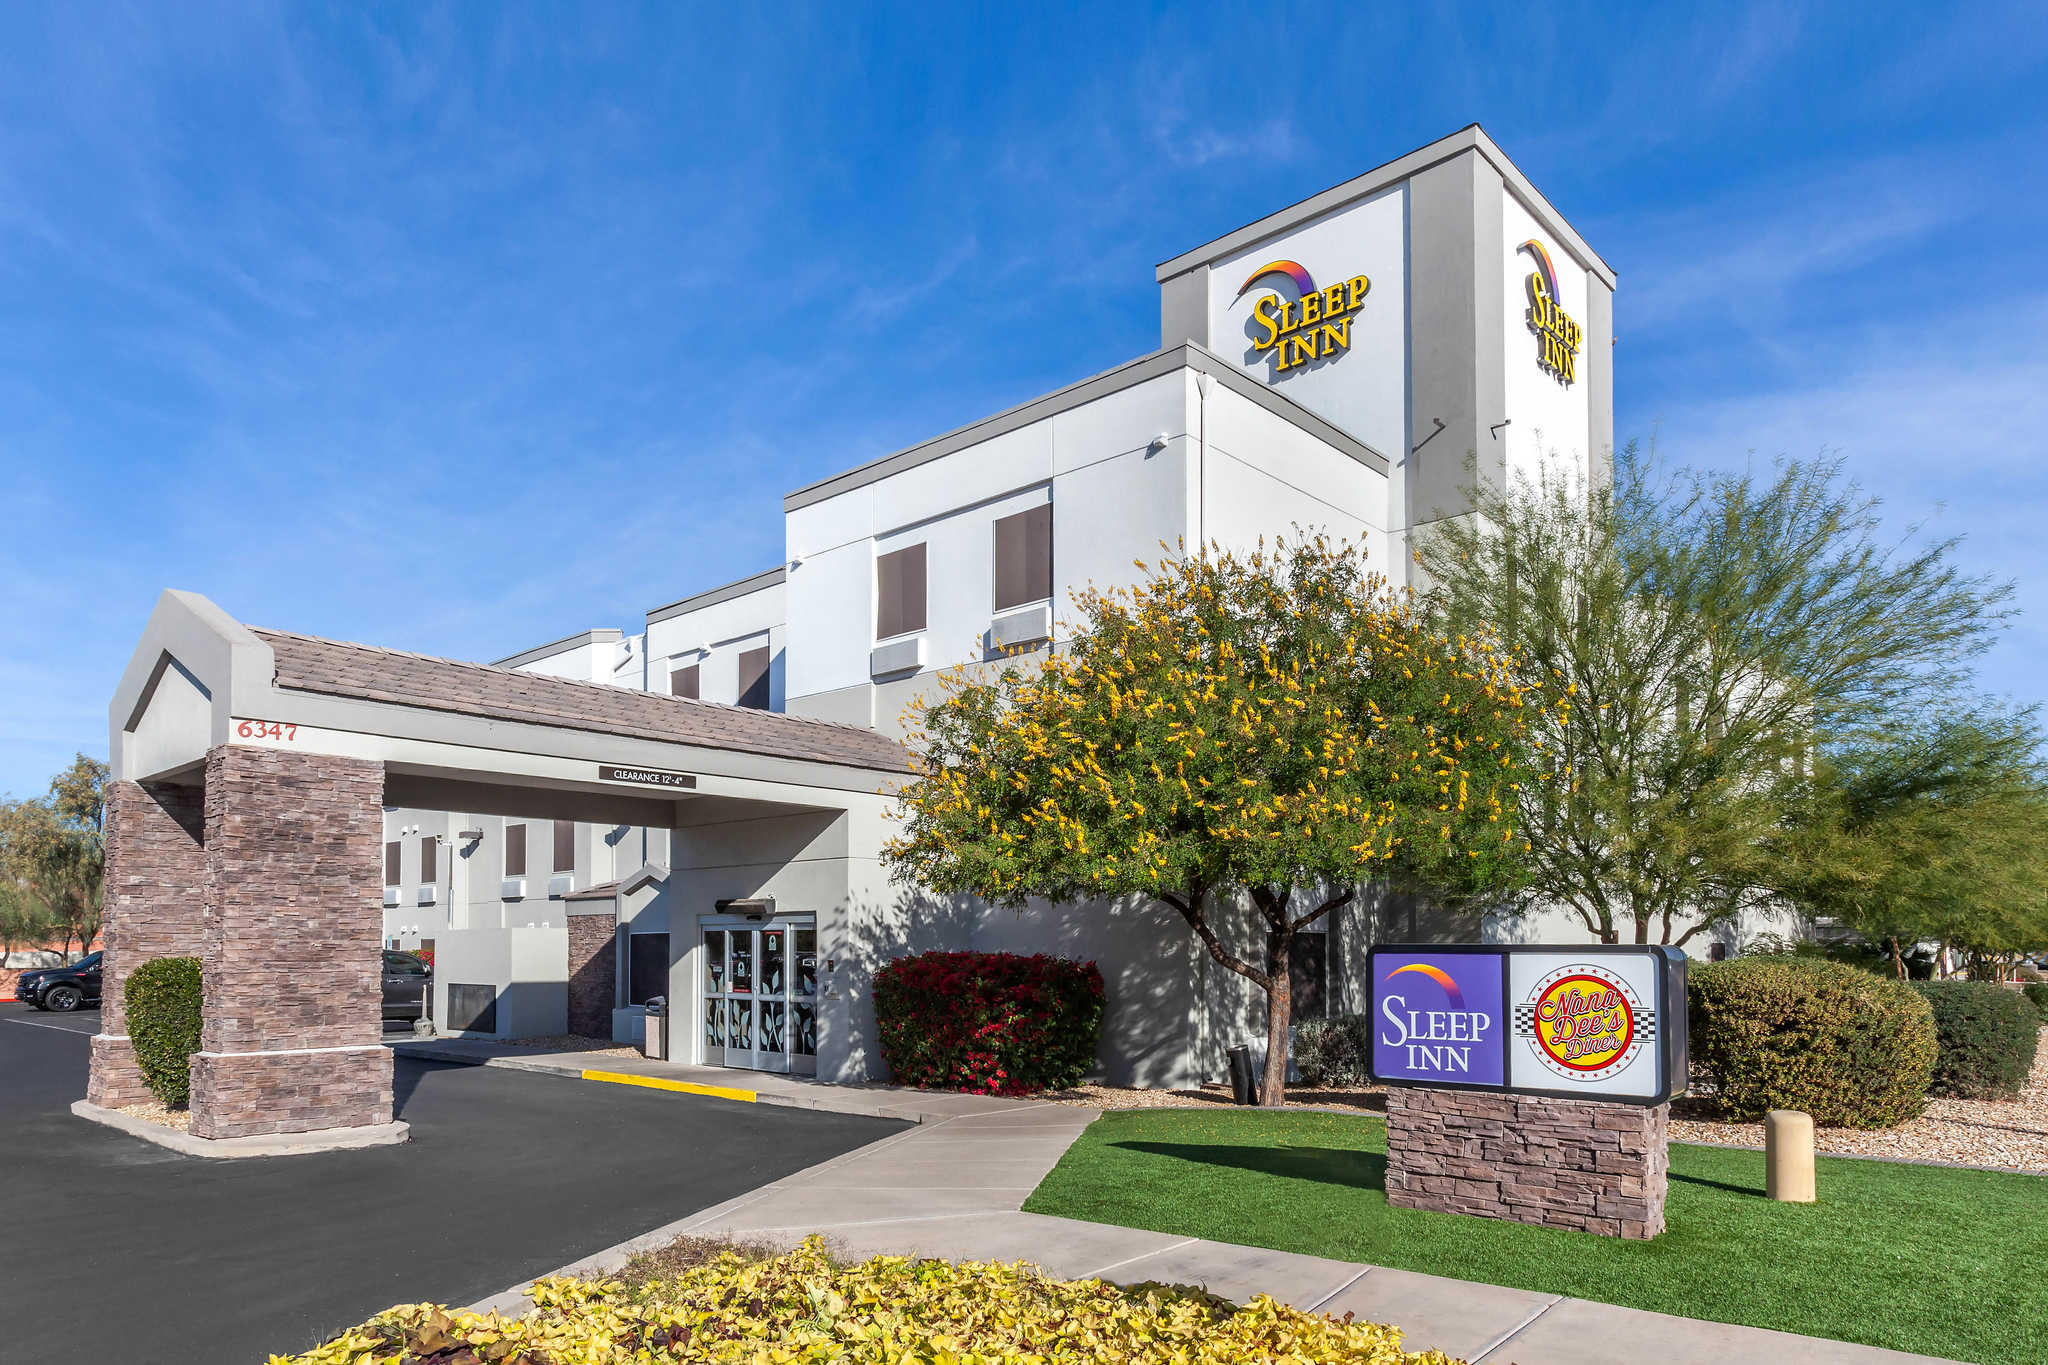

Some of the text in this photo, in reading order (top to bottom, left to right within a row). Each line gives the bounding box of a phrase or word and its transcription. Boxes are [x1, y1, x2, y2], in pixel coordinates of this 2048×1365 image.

[1254, 275, 1369, 350] SLEEP
[1532, 271, 1583, 352] SLEEP
[1275, 316, 1351, 371] INN
[1543, 330, 1576, 384] INN
[237, 719, 297, 741] 6347
[613, 769, 660, 783] CLEARANCE
[1382, 995, 1490, 1047] SLEEP
[1538, 987, 1621, 1021] Nana
[1550, 1009, 1625, 1045] Dee's
[1405, 1044, 1471, 1073] INN
[1564, 1032, 1622, 1060] Diner
